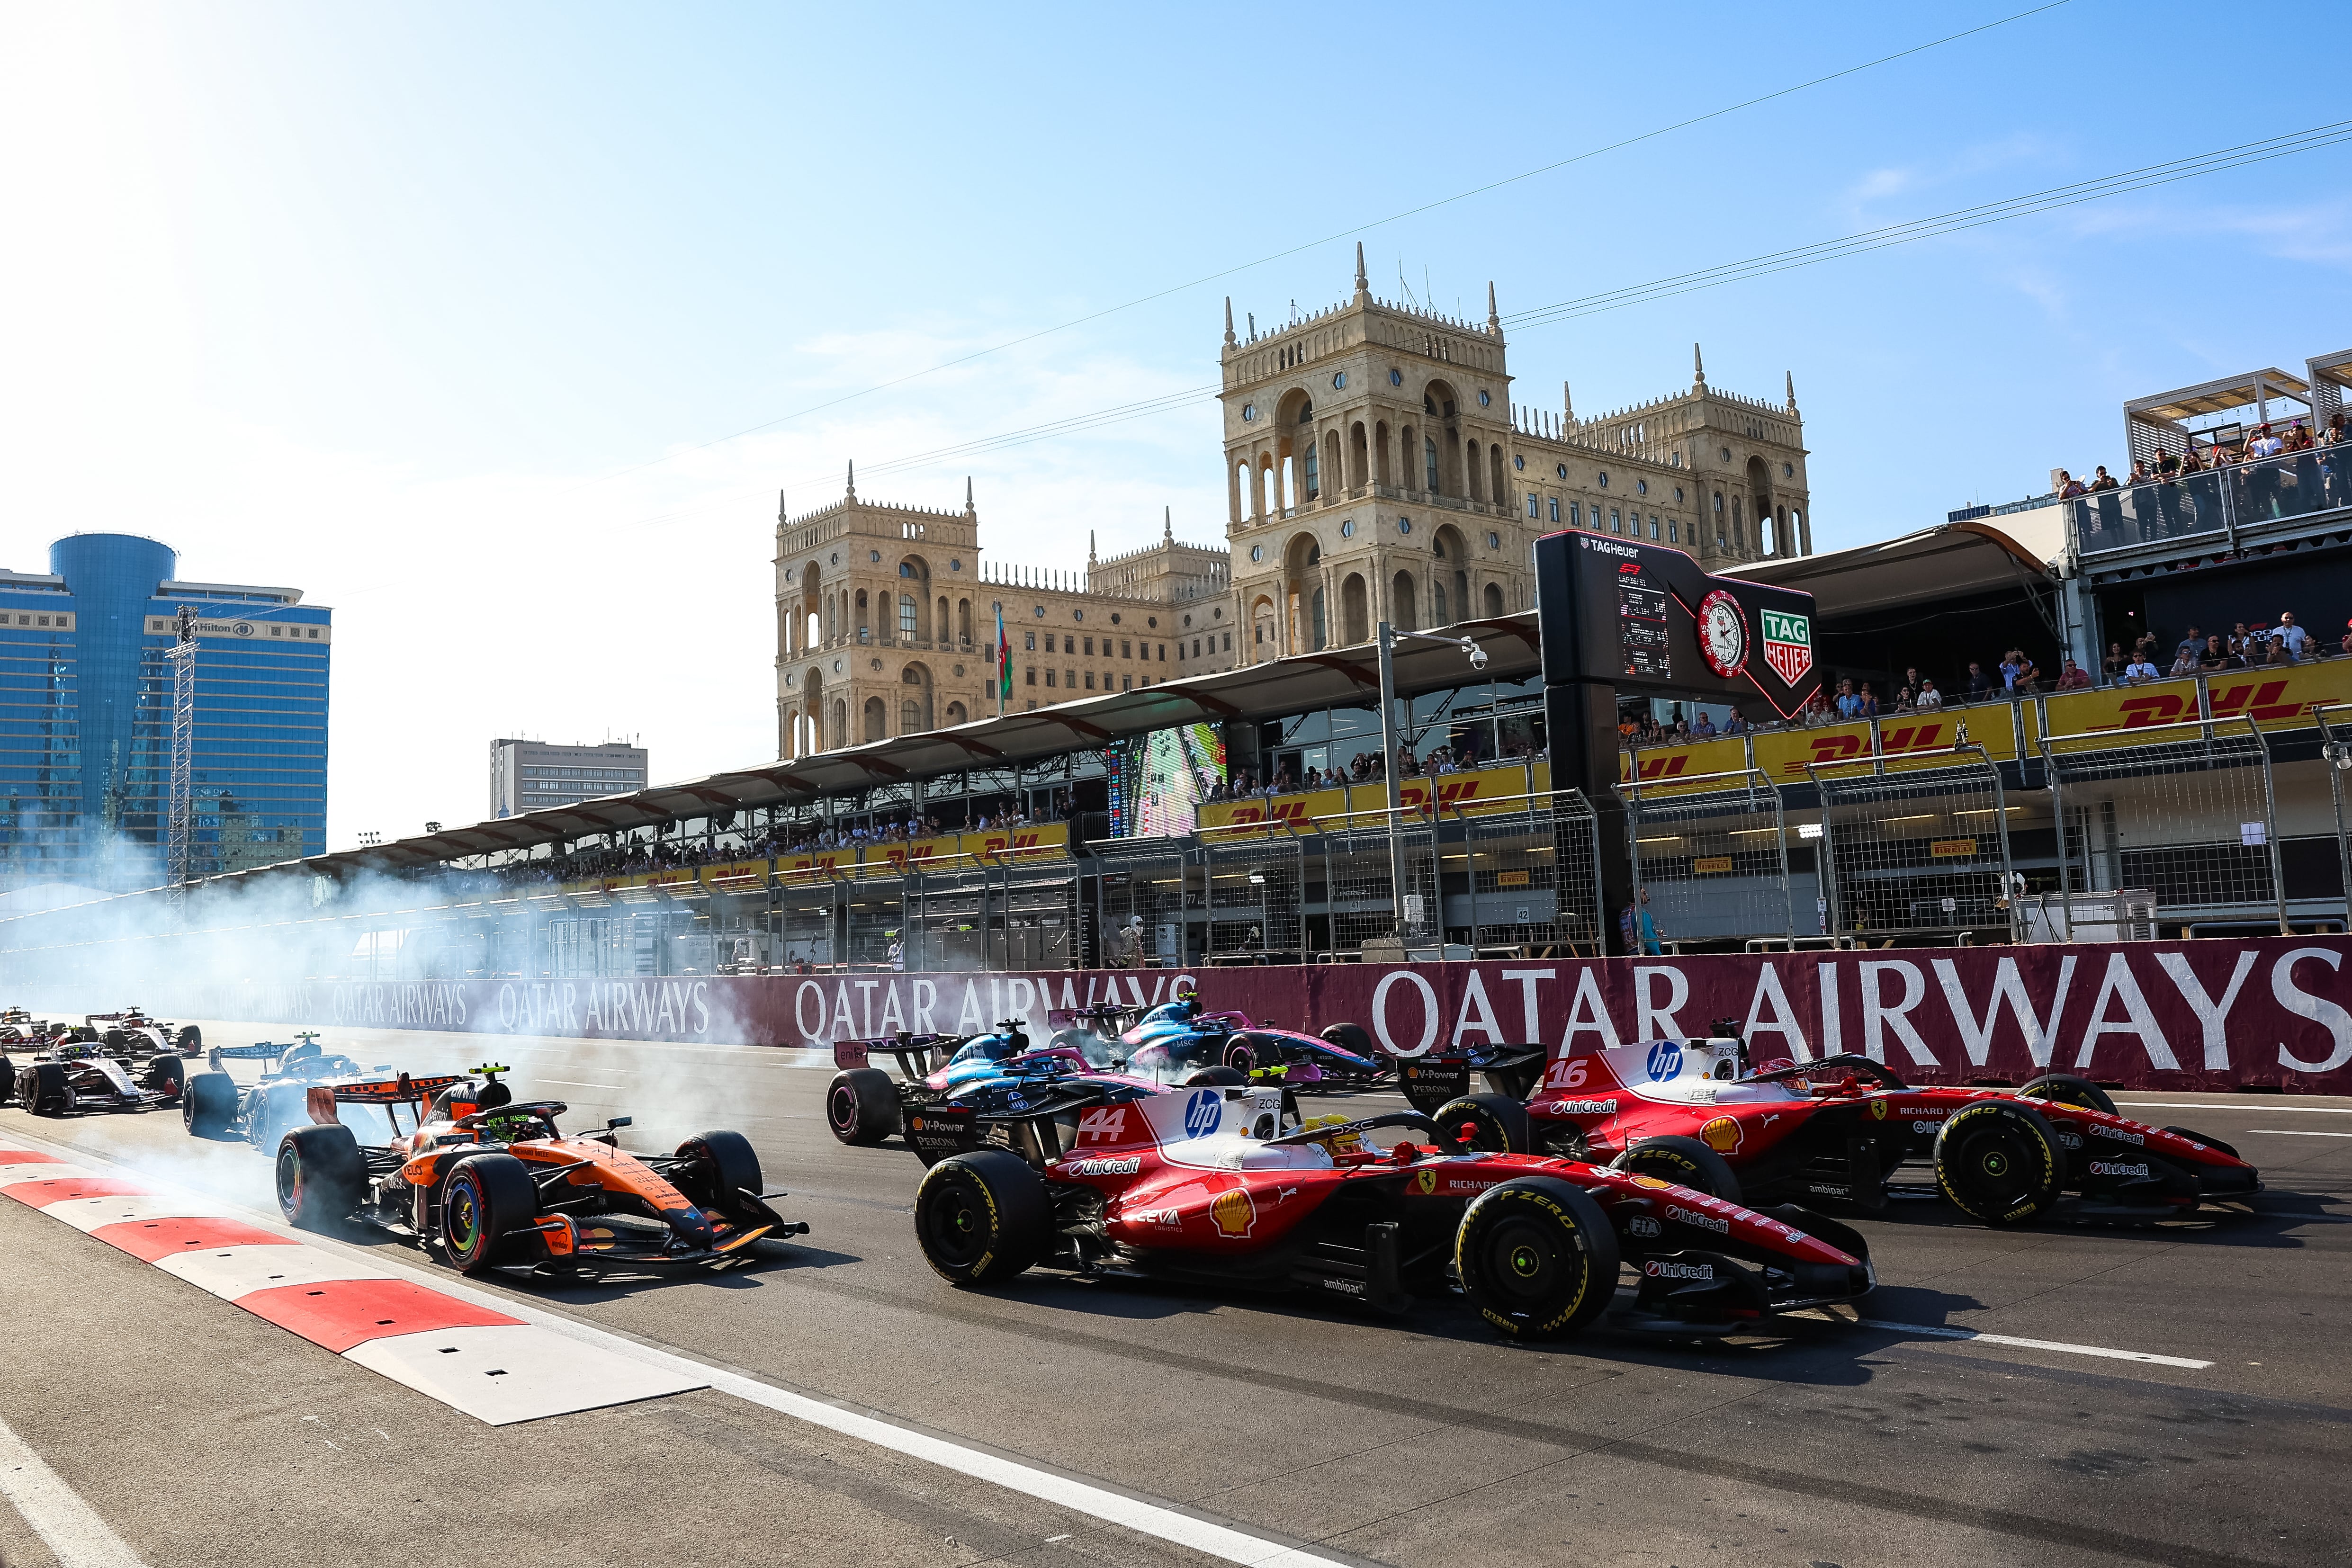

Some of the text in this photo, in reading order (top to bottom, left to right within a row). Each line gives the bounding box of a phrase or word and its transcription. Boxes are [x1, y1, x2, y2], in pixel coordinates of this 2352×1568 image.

[199, 623, 231, 633] Hilton
[1765, 615, 1806, 642] TAG
[1767, 644, 1810, 681] HEUER
[2119, 680, 2304, 730] DHL
[1810, 723, 1956, 767] DHL
[1622, 755, 1698, 790] HL
[1398, 780, 1482, 815] DHL
[1230, 801, 1316, 834] DHL
[984, 833, 1042, 859] DHL
[1934, 842, 1972, 854] PIRELLI
[792, 857, 837, 876] DHL
[886, 845, 936, 869] DHL
[1697, 859, 1729, 870] PIRELLI
[716, 867, 752, 885] DHL
[1500, 873, 1526, 883] PIRELLI
[1186, 893, 1196, 905] 77
[1518, 910, 1528, 920] 42
[333, 984, 467, 1026] QATAR AIRWAYS
[498, 979, 710, 1035] QATAR AIRWAYS
[795, 977, 940, 1045] QATAR
[1372, 947, 2352, 1073] QATAR AIRWAYS
[1053, 1015, 1066, 1024] eni
[1124, 1013, 1135, 1028] 43
[224, 1044, 290, 1054] PETRNA
[1176, 1039, 1194, 1048] MSC
[840, 1048, 853, 1061] eni
[933, 1046, 943, 1066] 10
[1650, 1041, 1681, 1083] hp
[1418, 1069, 1459, 1079] V-Power
[1546, 1059, 1588, 1089] 16
[1794, 1061, 1830, 1074] DXC
[1412, 1084, 1451, 1093] PERONI
[430, 1105, 449, 1121] Gemini
[1188, 1089, 1219, 1140] hp
[1564, 1098, 1617, 1114] UniCredit
[923, 1120, 964, 1132] V-Power
[1079, 1108, 1126, 1142] 44
[1949, 1107, 1997, 1129] ZERO
[1330, 1120, 1375, 1136] DXC
[2101, 1125, 2145, 1146] UniCredit
[916, 1136, 959, 1147] PERONI
[512, 1148, 549, 1158] RICHARD MILLE
[1641, 1149, 1697, 1171] ZERO
[404, 1164, 423, 1176] VELO
[1083, 1156, 1142, 1176] UniCredit
[2102, 1162, 2148, 1176] UniCredit
[1809, 1183, 1845, 1198] ambipar
[1500, 1190, 1576, 1229] P ZERO
[2004, 1202, 2037, 1222] PIRELLI
[1631, 1219, 1659, 1234] FIA
[1678, 1208, 1729, 1234] UniCredit
[971, 1251, 994, 1278] PIRELLI
[1660, 1262, 1713, 1280] UniCredit
[1324, 1278, 1361, 1295] ambipar
[1481, 1307, 1519, 1334] PIRELLI
